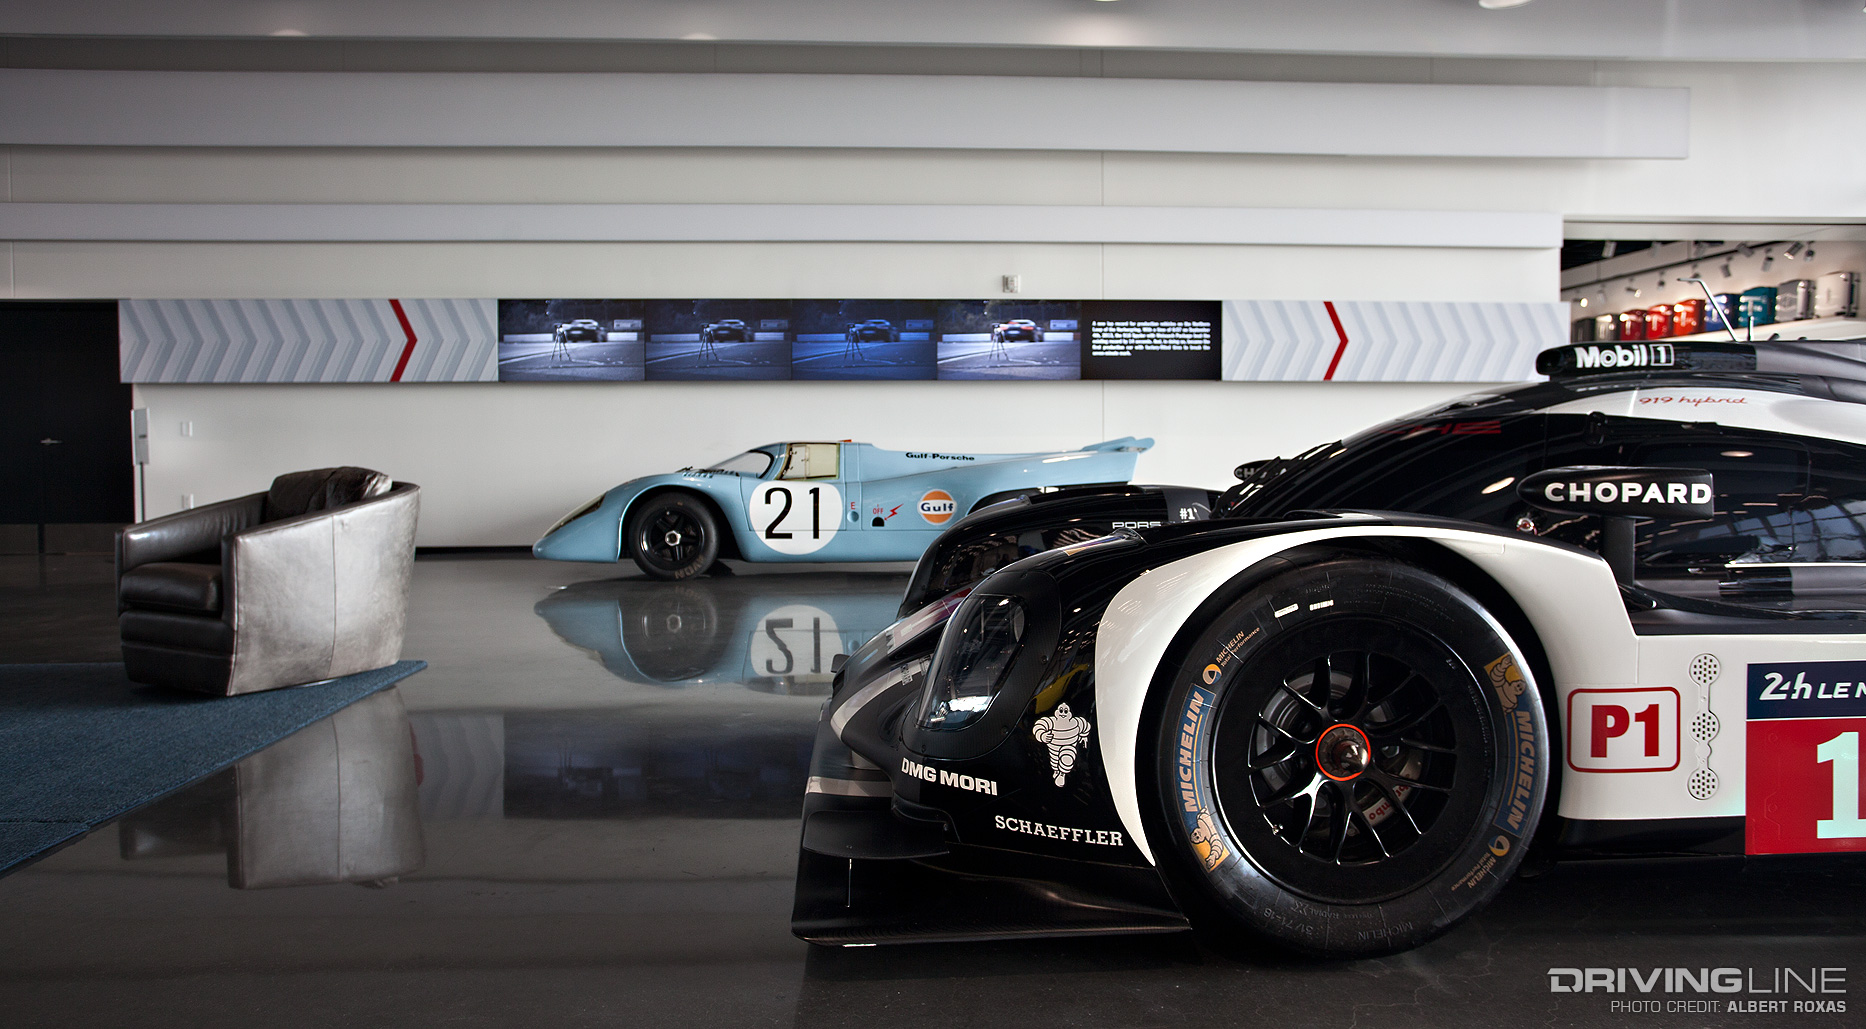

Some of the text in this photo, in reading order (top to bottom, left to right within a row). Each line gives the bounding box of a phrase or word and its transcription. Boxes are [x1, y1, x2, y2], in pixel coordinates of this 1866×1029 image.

[1574, 345, 1647, 368] Mobil
[1639, 396, 1747, 407] 919 hybrid
[905, 452, 975, 461] Gulf-Porsche
[850, 501, 856, 510] E
[1544, 482, 1712, 504] CHOPARD
[764, 487, 820, 539] 21
[872, 507, 884, 515] OFF
[920, 502, 954, 512] Gulf
[1112, 521, 1162, 530] PORS
[1231, 627, 1260, 653] erformance
[1759, 671, 1812, 700] 24h
[1817, 682, 1852, 699] LE
[1590, 703, 1660, 758] P1
[1179, 691, 1204, 812] MICHELIN
[901, 757, 997, 796] DMG MORI
[1507, 710, 1535, 830] MICHELIN
[1816, 731, 1866, 839] 1
[995, 815, 1123, 846] SCHAEFFLER
